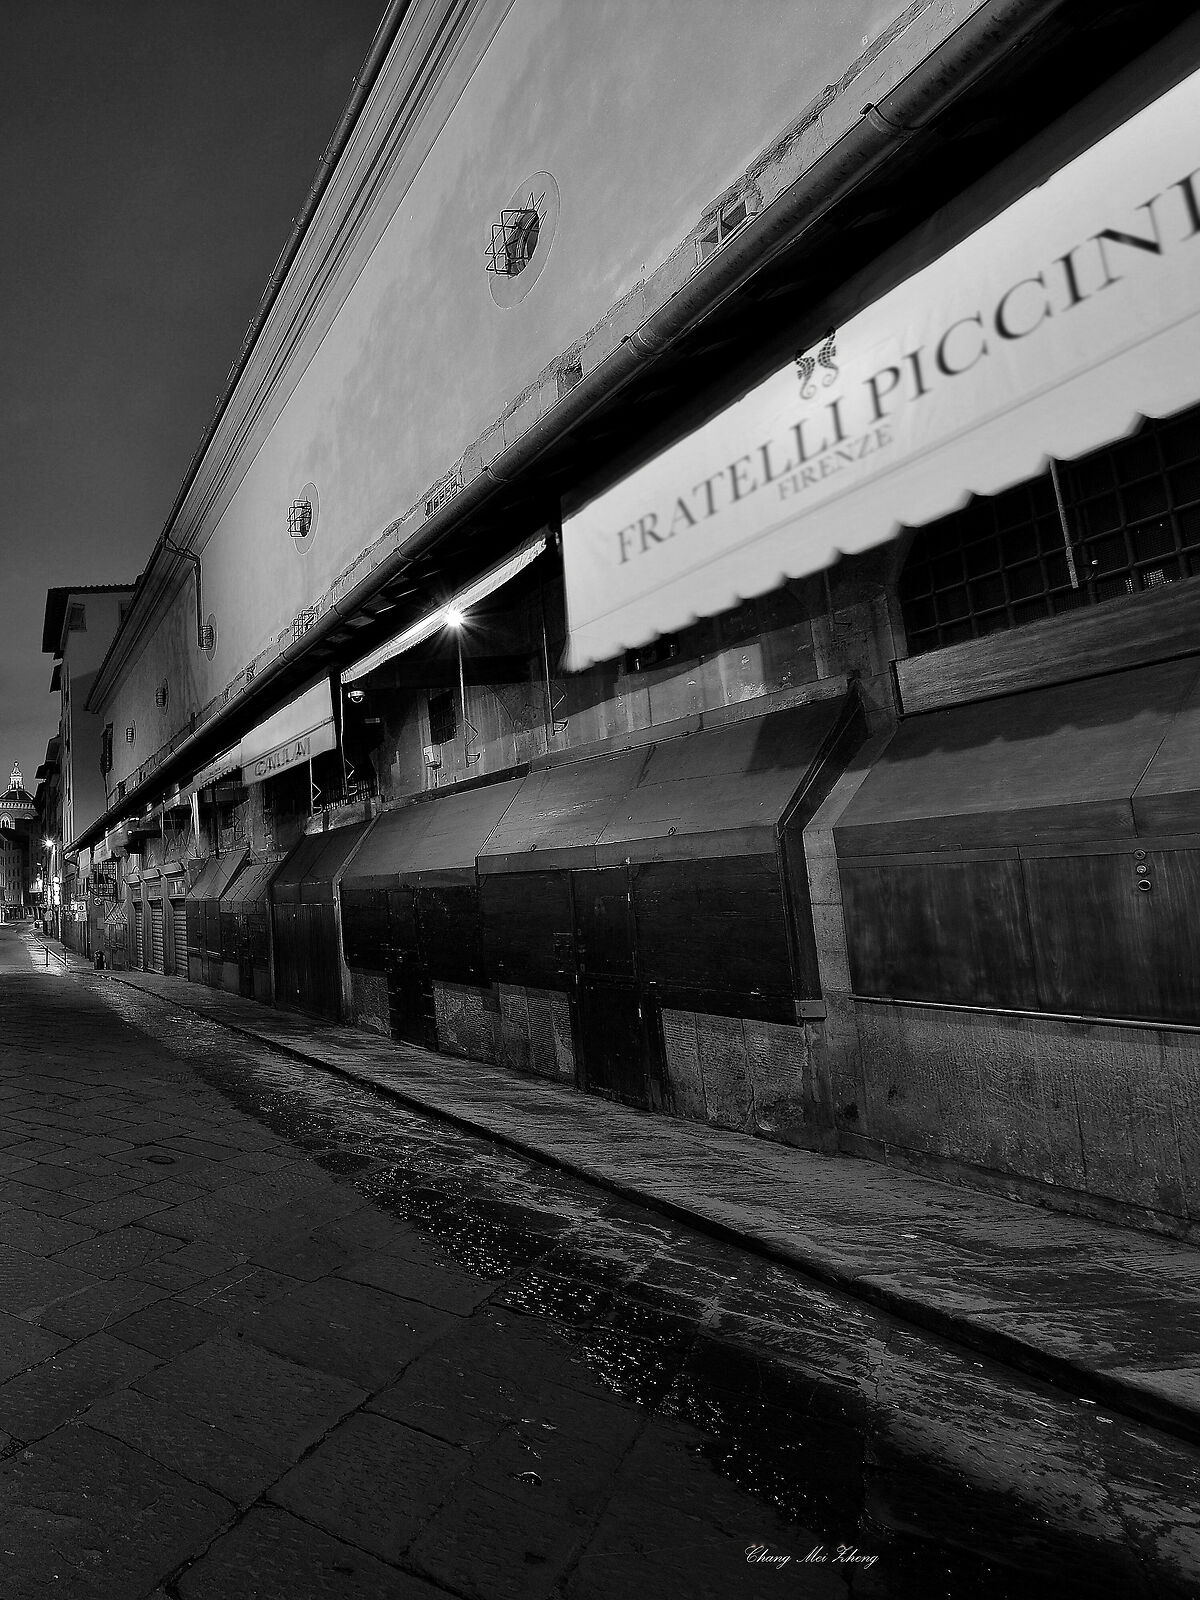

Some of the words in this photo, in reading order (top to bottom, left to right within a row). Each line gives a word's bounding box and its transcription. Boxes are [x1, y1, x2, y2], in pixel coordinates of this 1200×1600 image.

[617, 396, 850, 565] FRATELLI
[861, 168, 1200, 425] PICCINI
[778, 422, 895, 501] FIRENZE
